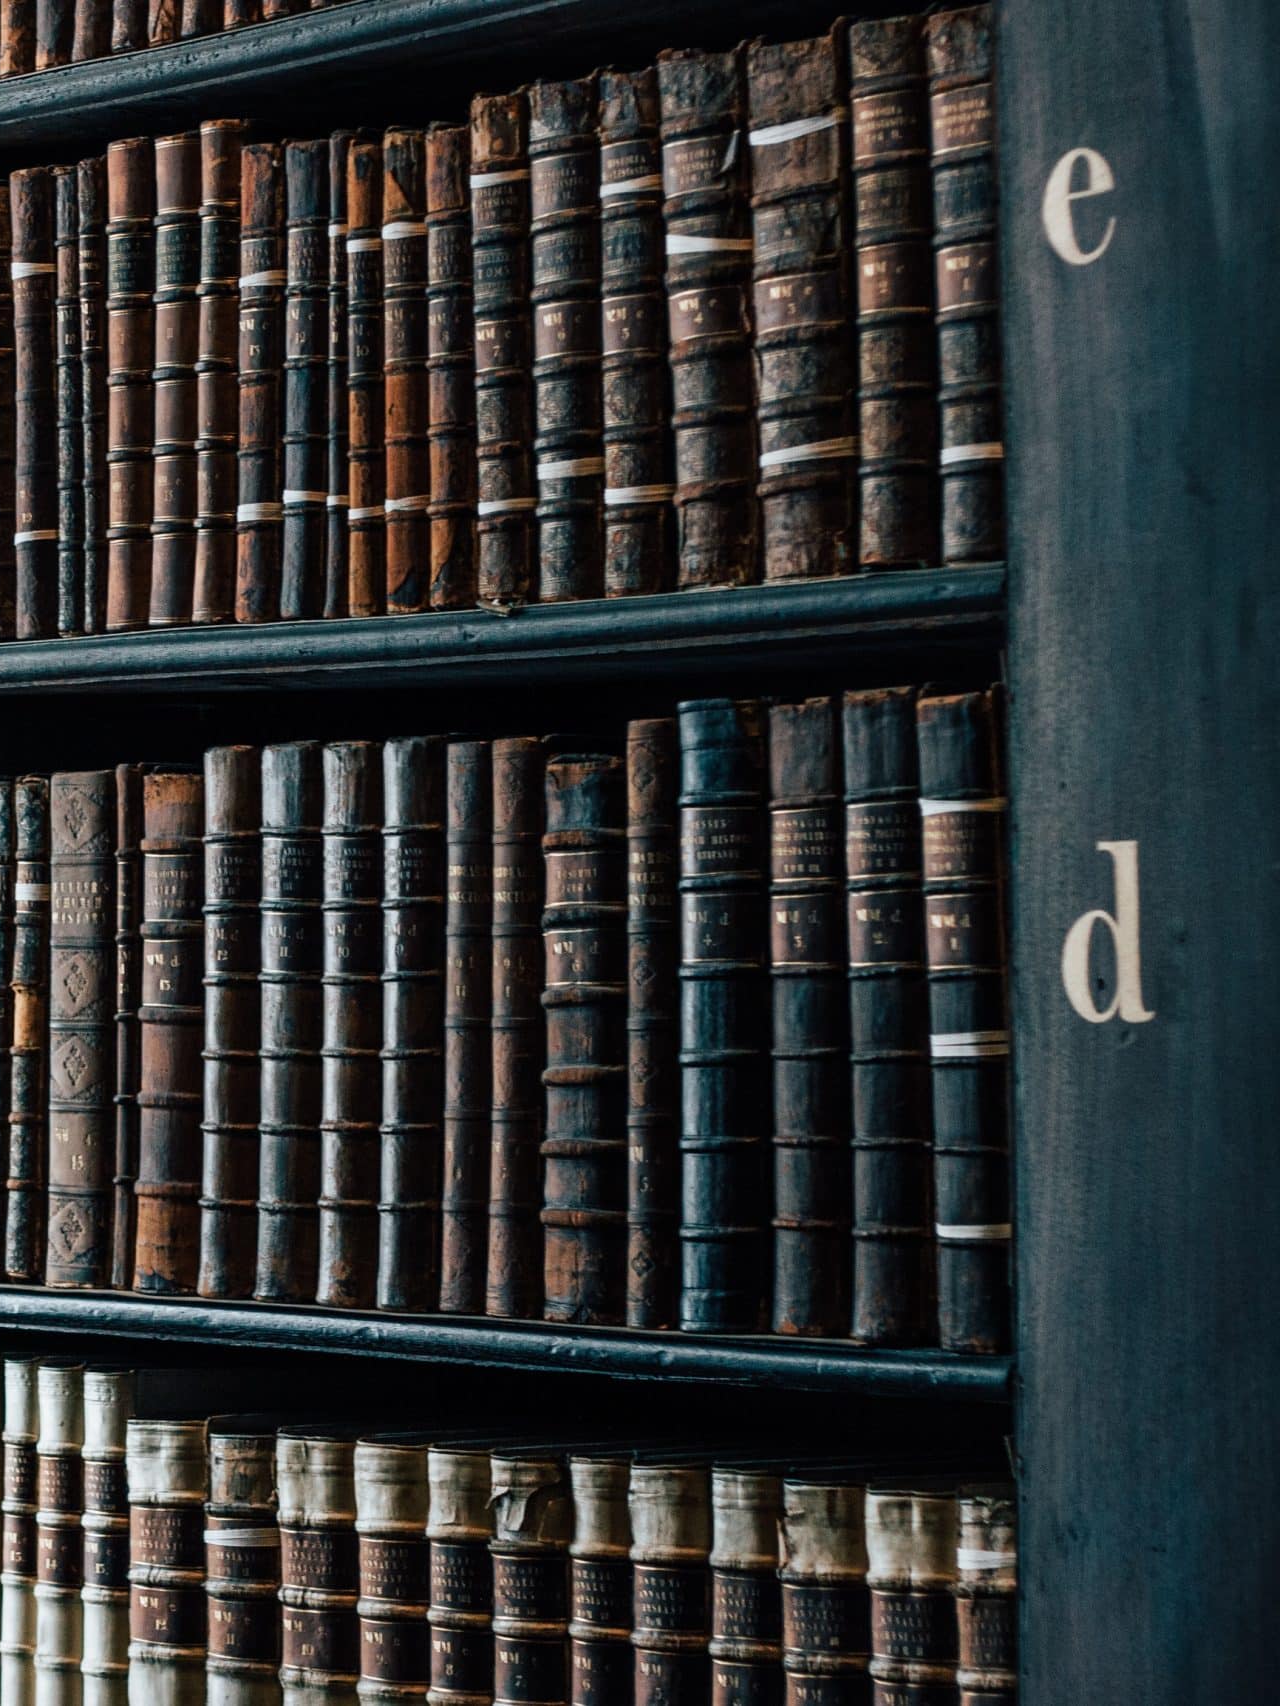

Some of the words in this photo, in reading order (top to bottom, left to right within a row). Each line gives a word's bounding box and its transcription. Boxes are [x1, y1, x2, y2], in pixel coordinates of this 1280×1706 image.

[1040, 145, 1117, 266] e
[770, 285, 792, 299] MM
[693, 312, 703, 324] 4
[476, 327, 495, 340] MM
[355, 346, 369, 358] 10
[493, 345, 500, 357] 7
[54, 896, 103, 909] CHURCH
[1061, 839, 1155, 1024] d
[553, 941, 572, 955] MM
[139, 1595, 159, 1609] MM
[283, 1619, 303, 1632] MM
[364, 1631, 384, 1645] MM
[445, 1663, 454, 1676] 8
[717, 1672, 739, 1689] MM
[795, 1686, 822, 1702] MM
